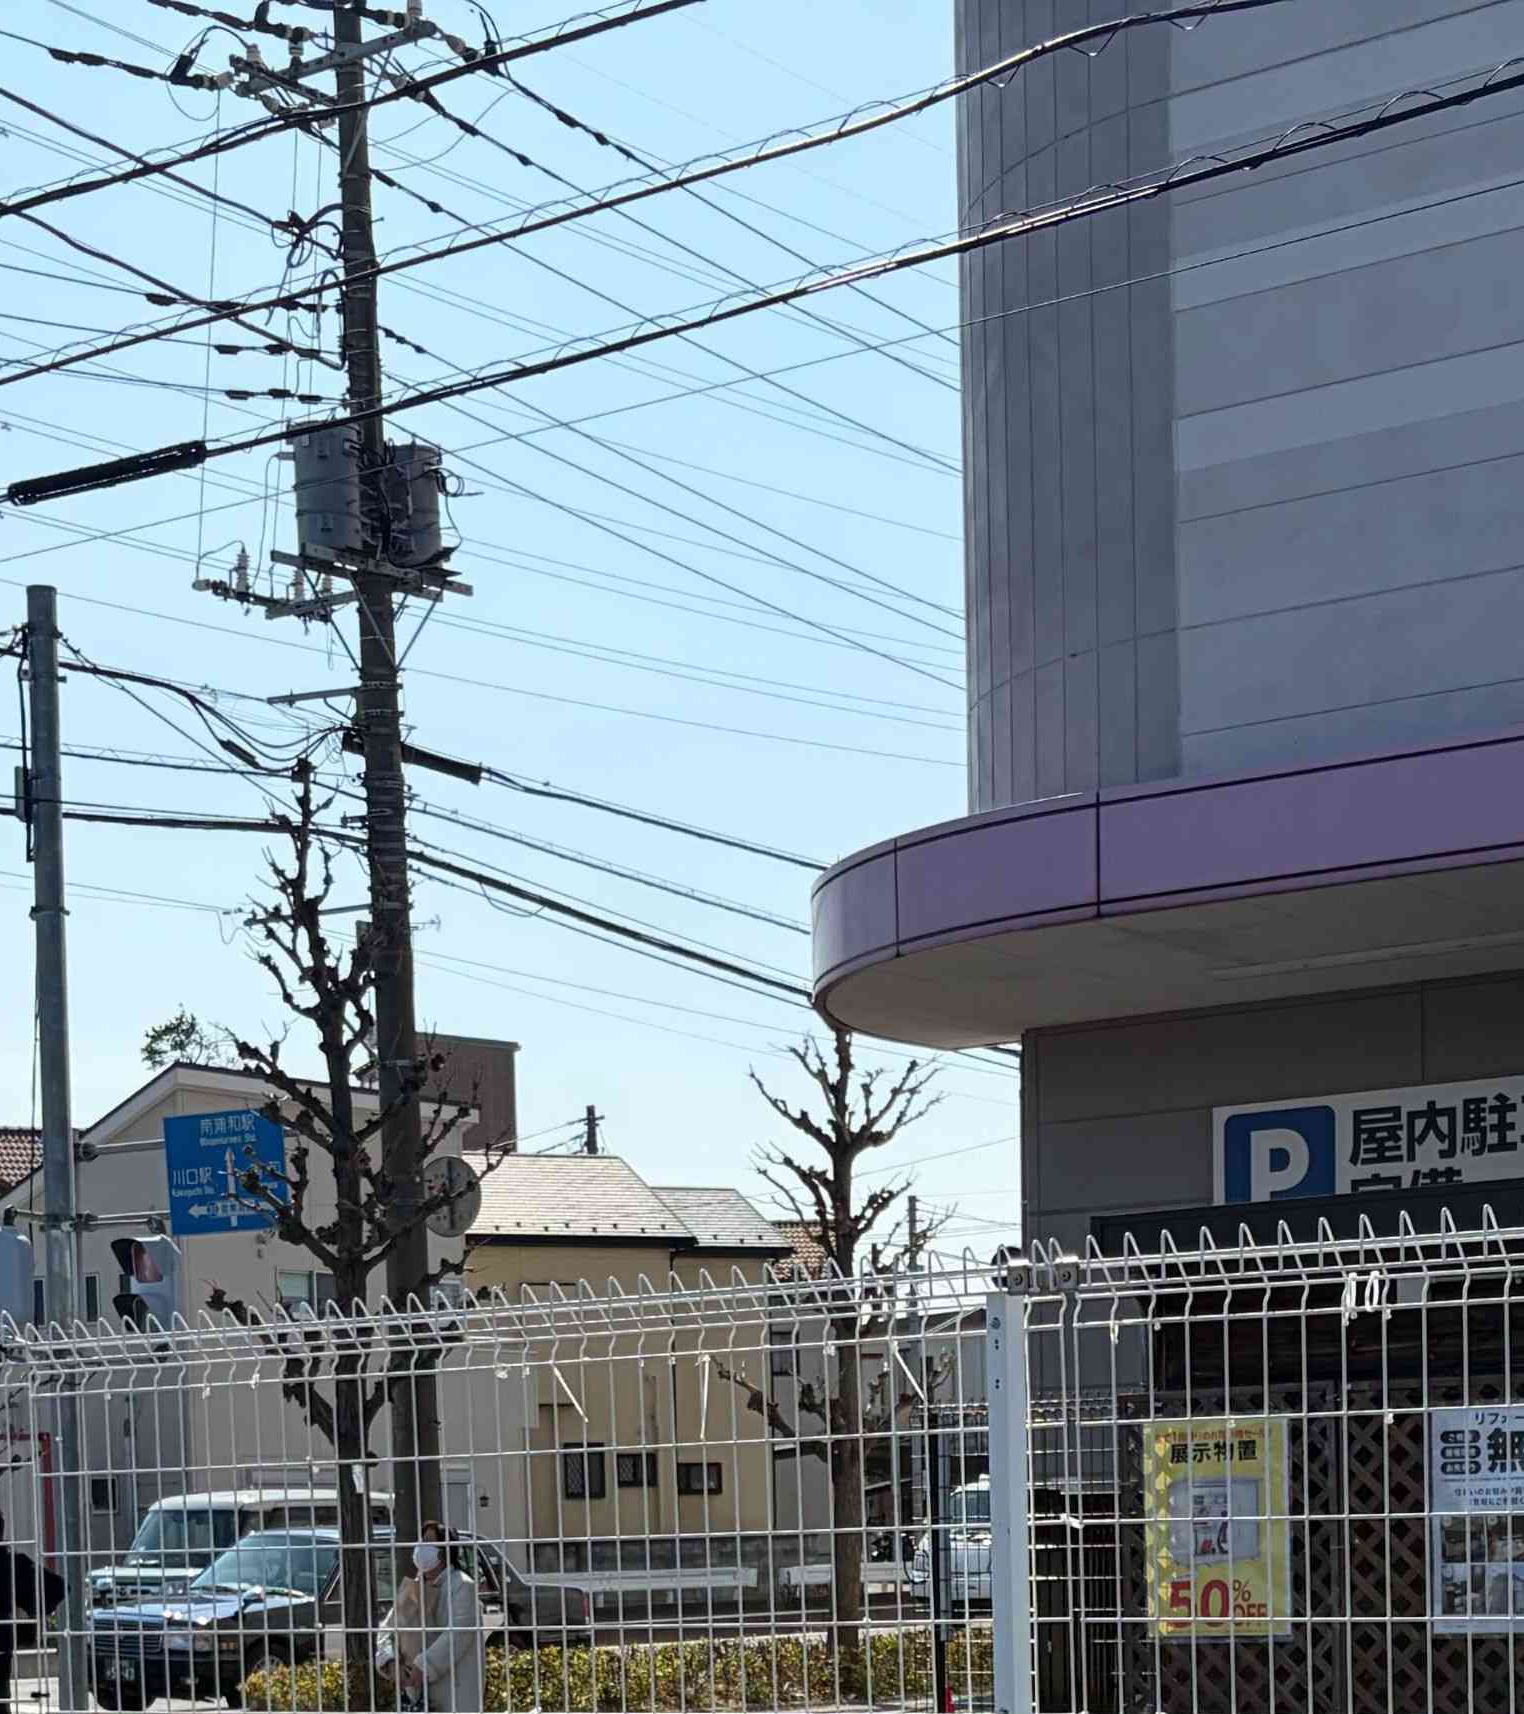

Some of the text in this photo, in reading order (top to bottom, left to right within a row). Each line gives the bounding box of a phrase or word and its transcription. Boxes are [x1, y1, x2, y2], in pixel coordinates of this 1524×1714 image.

[173, 1167, 212, 1185] 川口駅
[1170, 1440, 1258, 1465] 展示物置
